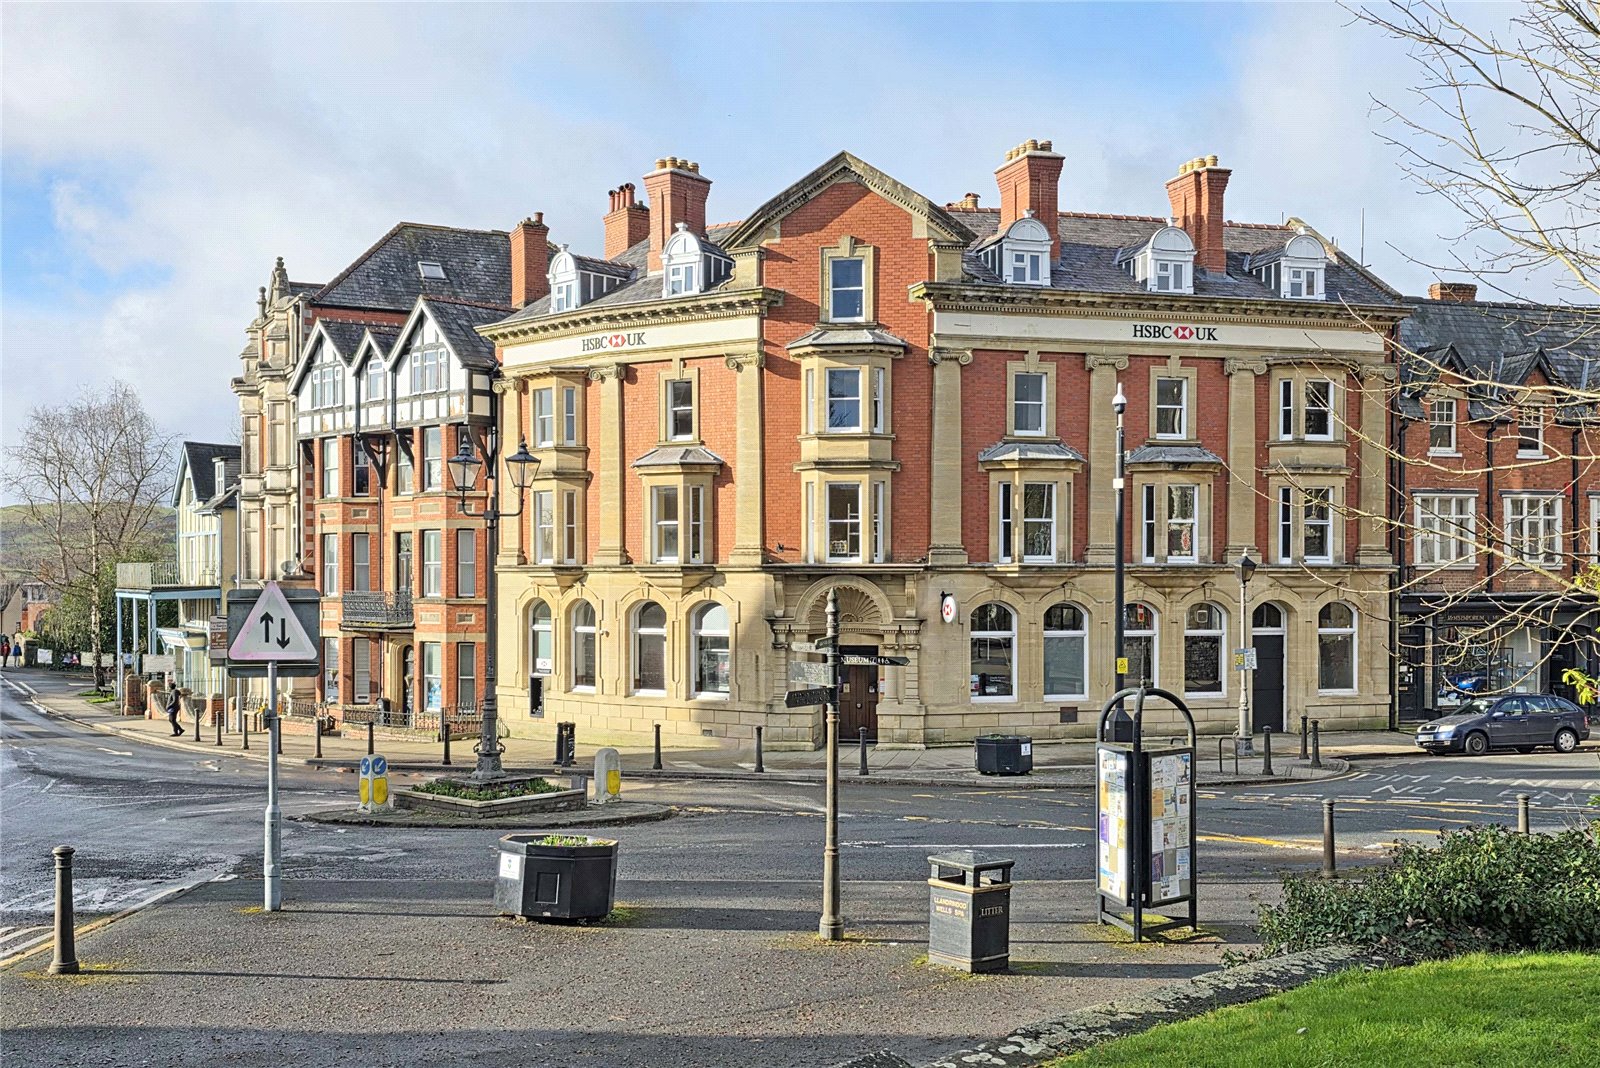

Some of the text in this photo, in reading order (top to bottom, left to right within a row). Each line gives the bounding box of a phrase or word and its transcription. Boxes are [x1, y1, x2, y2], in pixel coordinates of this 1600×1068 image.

[1132, 324, 1218, 341] HSBC UK
[582, 332, 646, 351] HSBC UK
[1348, 772, 1431, 783] DIM
[1371, 784, 1446, 795] NO
[954, 908, 965, 917] SPA
[981, 905, 1004, 916] LITTER
